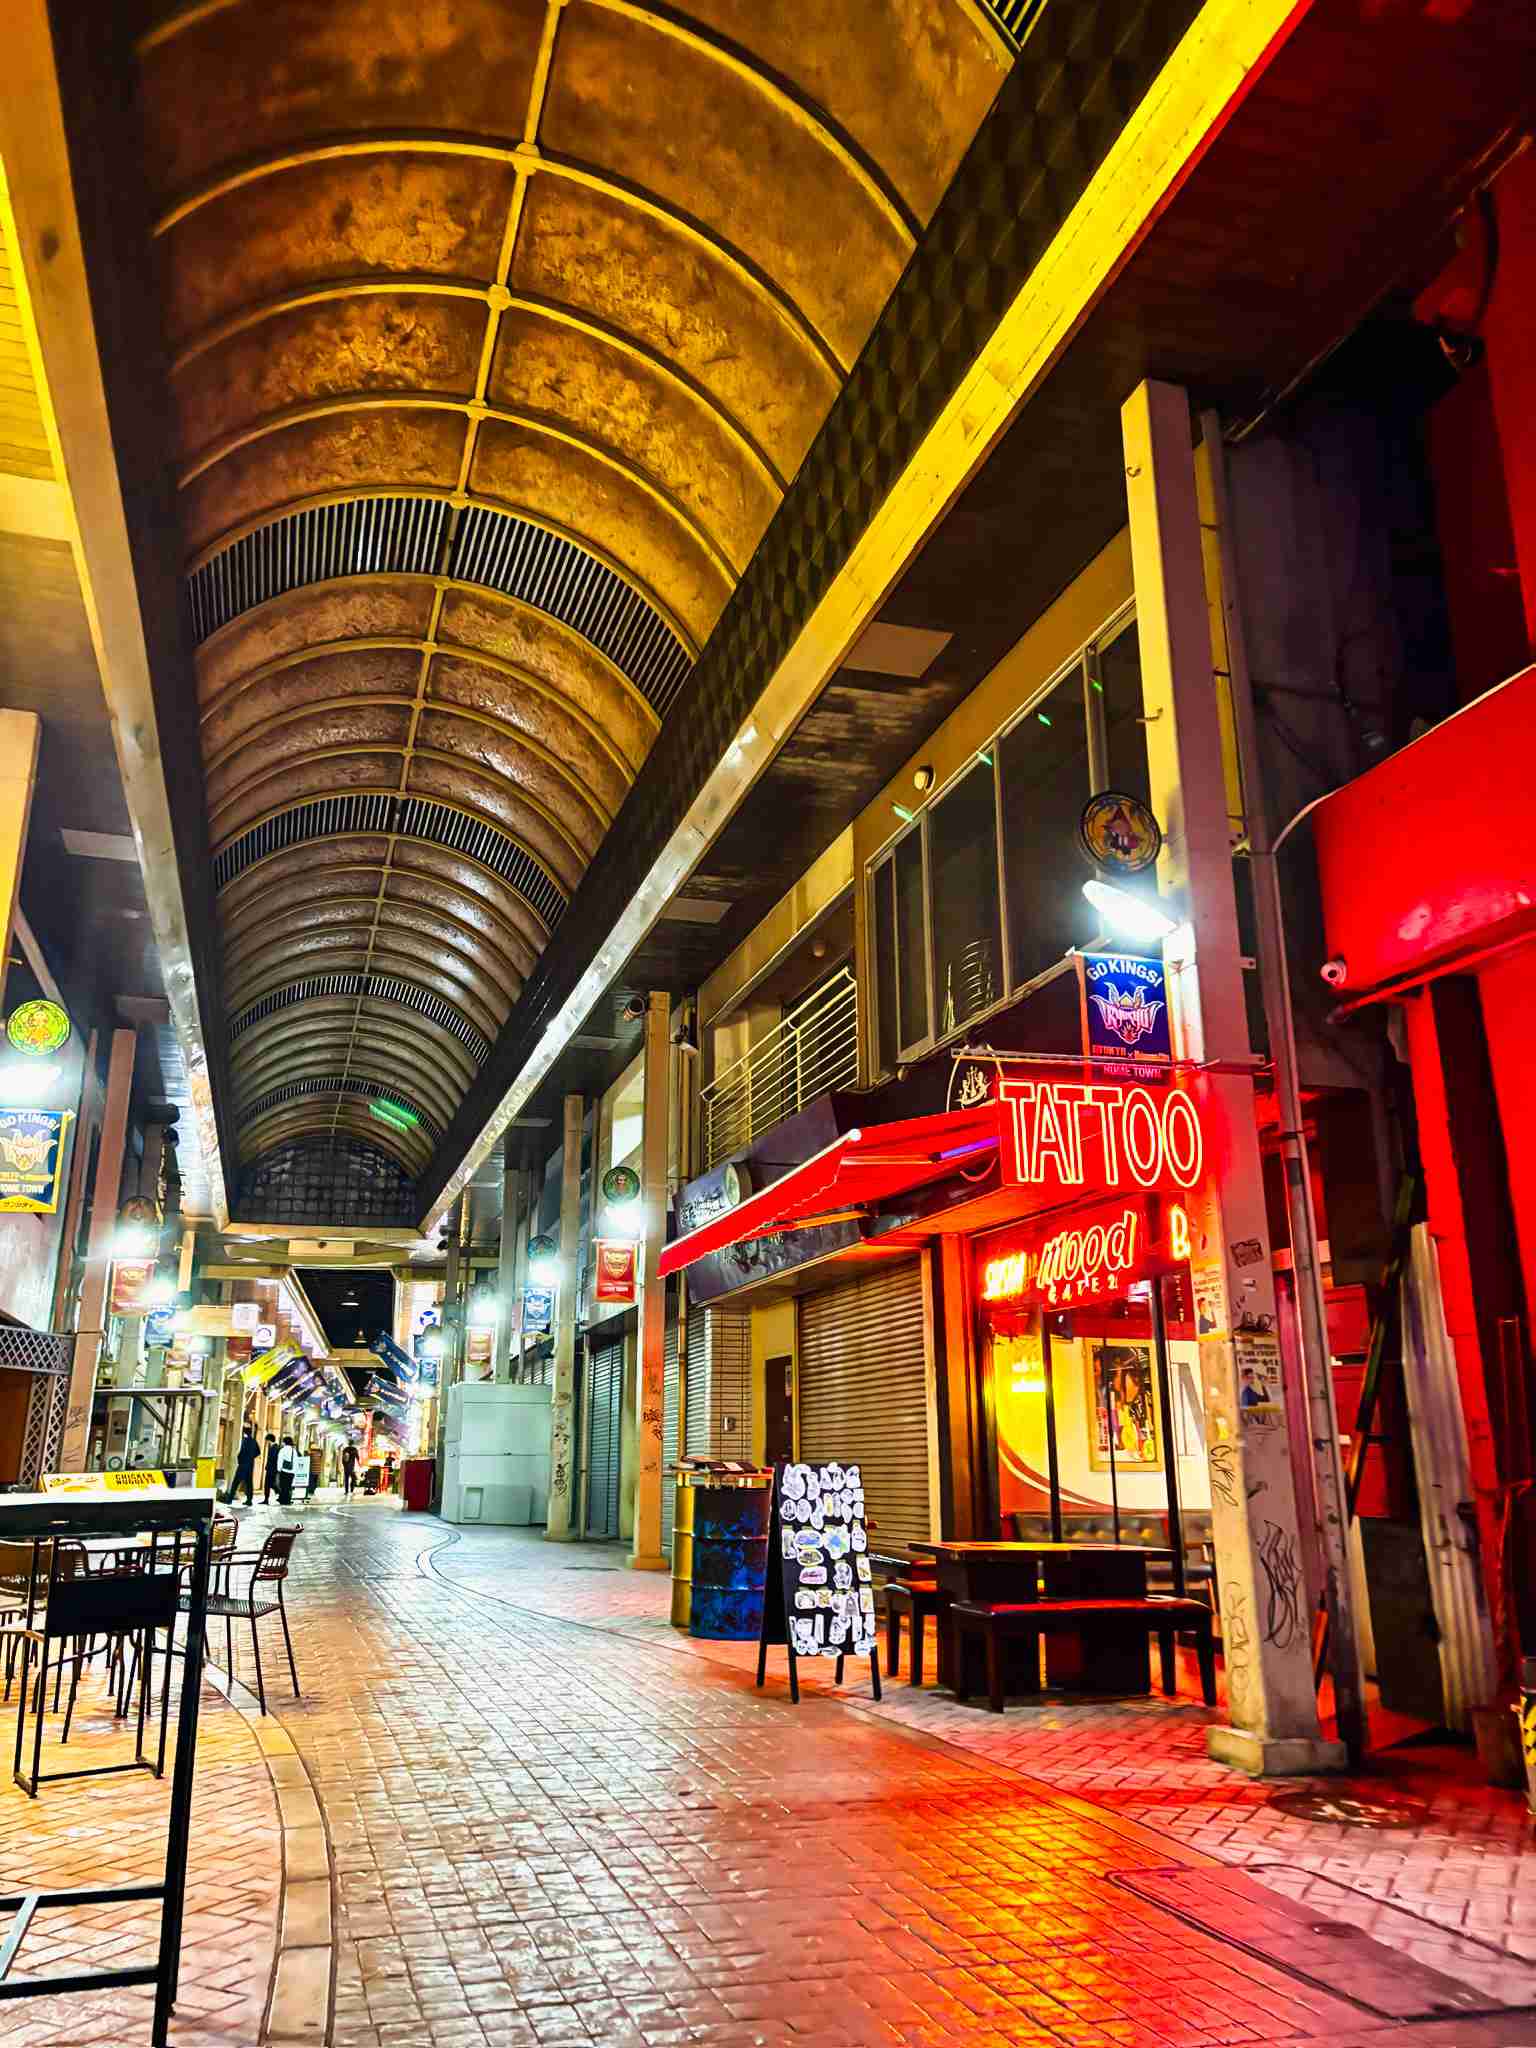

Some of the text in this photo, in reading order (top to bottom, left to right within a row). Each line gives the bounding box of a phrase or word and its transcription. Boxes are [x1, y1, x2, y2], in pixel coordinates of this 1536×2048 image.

[1086, 959, 1164, 988] GO KINGS!
[999, 1080, 1203, 1187] TATTOO
